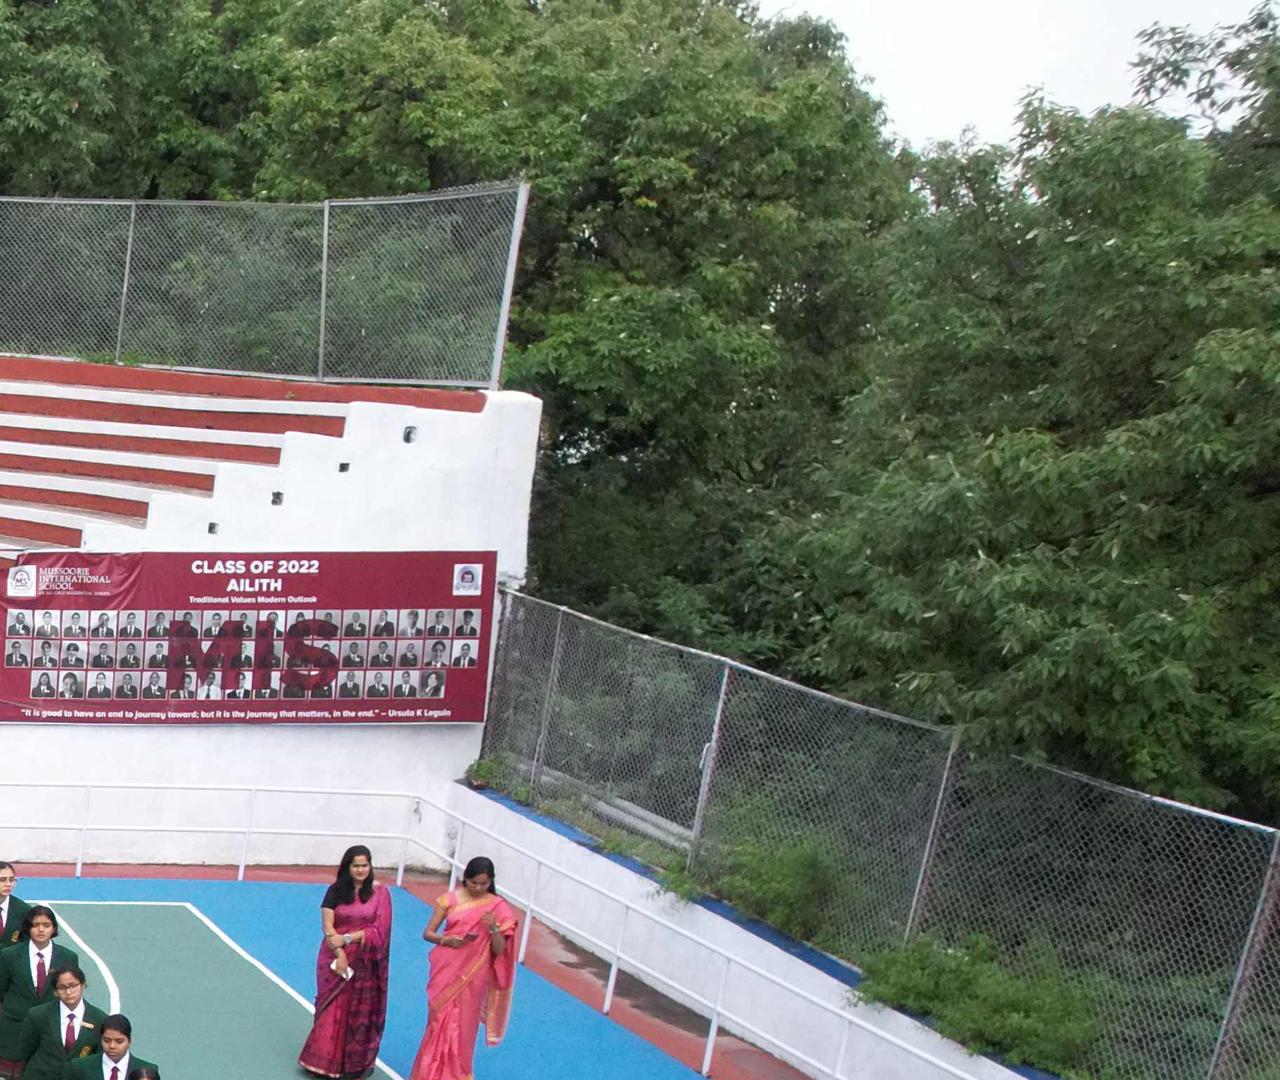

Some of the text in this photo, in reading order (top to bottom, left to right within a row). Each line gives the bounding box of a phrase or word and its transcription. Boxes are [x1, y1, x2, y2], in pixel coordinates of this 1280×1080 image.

[40, 567, 90, 575] MUSSOORIE
[191, 560, 320, 574] CLASS OF 2022
[40, 575, 111, 584] INTERNATIONAL
[38, 582, 74, 590] SCHOOL
[226, 578, 282, 592] AILITH
[189, 596, 318, 604] Traditional Values Modern Outlook
[165, 618, 340, 691] MIS
[42, 710, 62, 718] good
[134, 710, 166, 720] journey
[216, 710, 222, 718] it
[223, 710, 230, 718] is
[246, 710, 278, 719] journey
[280, 710, 296, 718] that
[424, 709, 451, 718] Leguin
